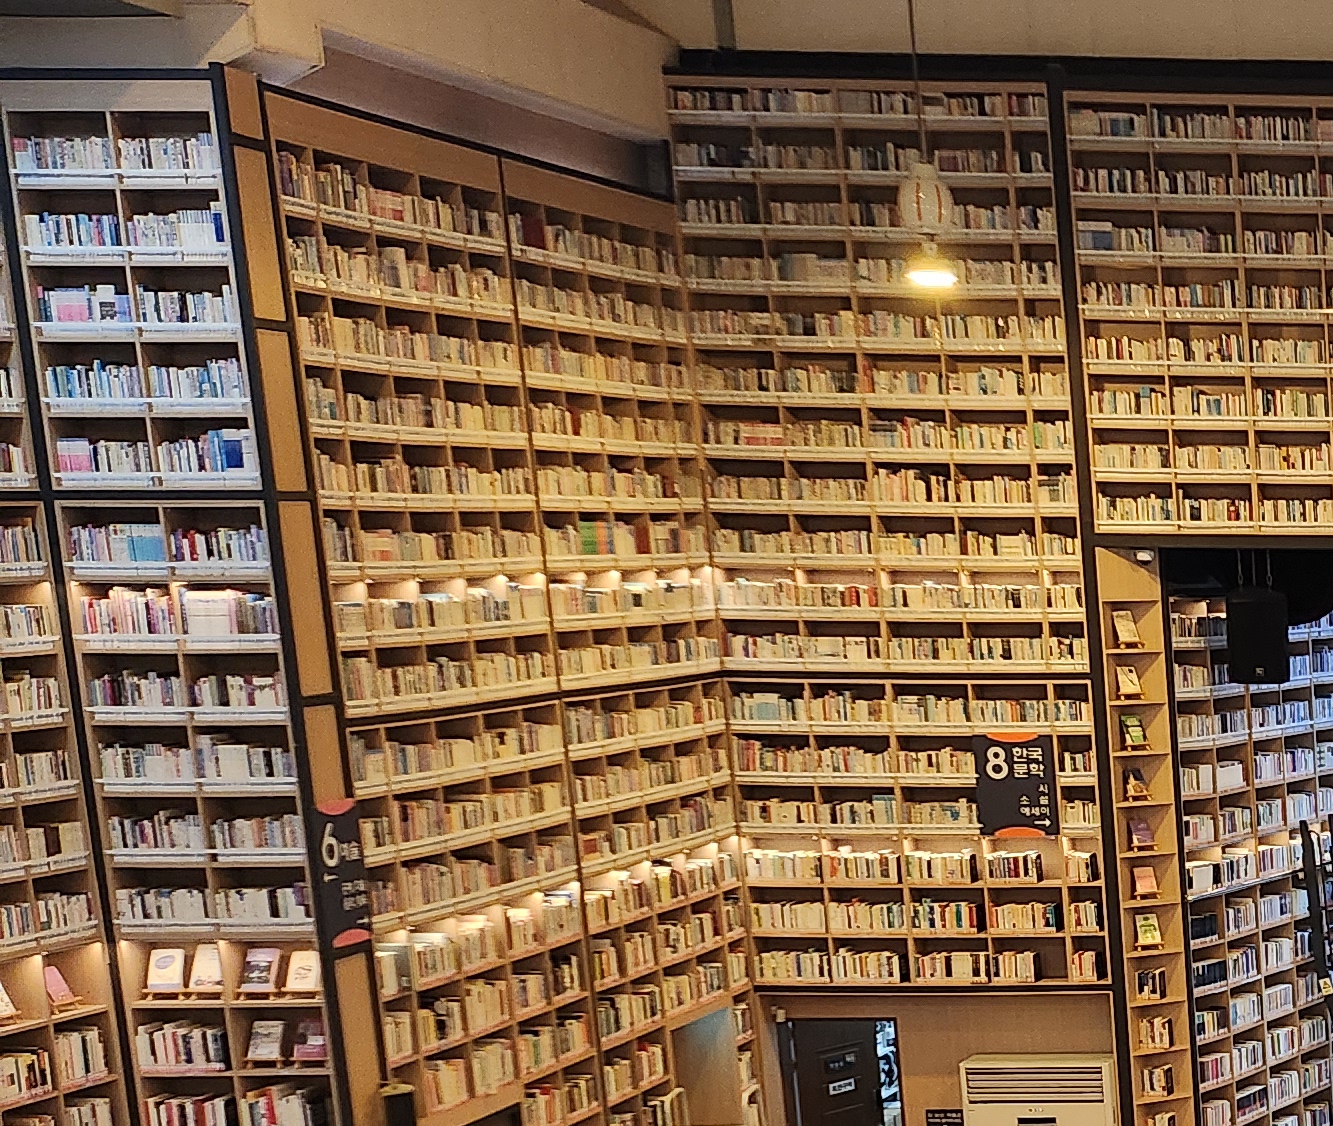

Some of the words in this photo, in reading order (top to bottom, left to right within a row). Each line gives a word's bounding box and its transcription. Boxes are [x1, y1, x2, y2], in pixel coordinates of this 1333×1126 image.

[985, 746, 1009, 780] 8
[1011, 746, 1043, 762] 한국
[1013, 762, 1045, 779] 문학
[321, 822, 341, 868] 6
